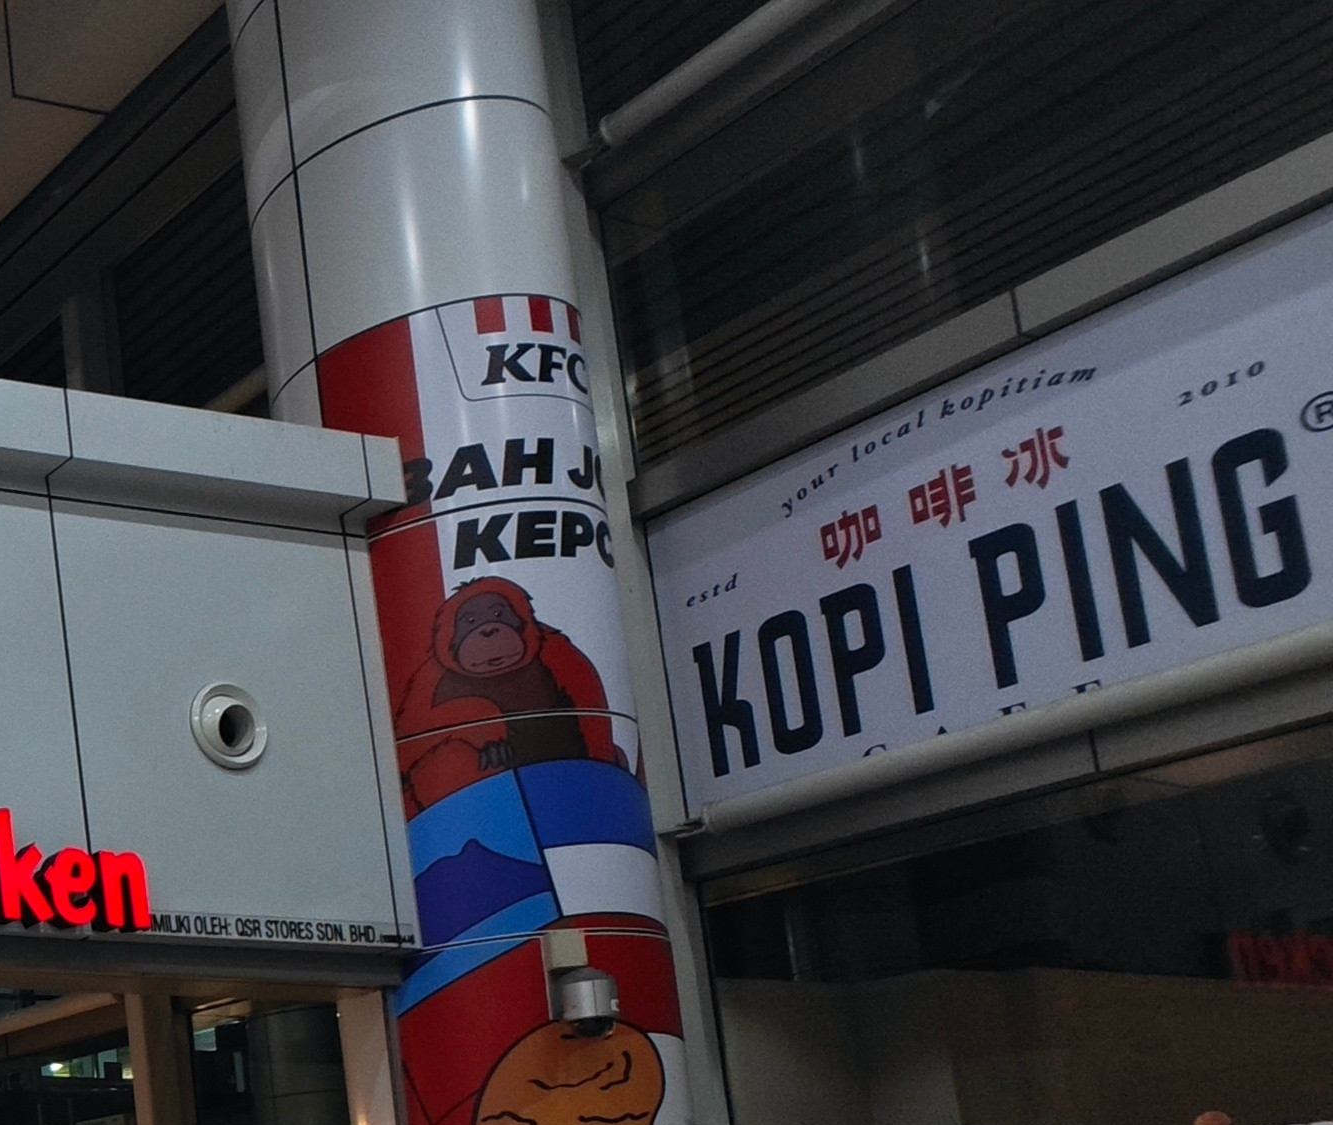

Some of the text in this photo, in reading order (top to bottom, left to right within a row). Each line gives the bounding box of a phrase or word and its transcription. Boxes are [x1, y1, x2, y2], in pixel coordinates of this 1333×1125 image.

[1177, 360, 1265, 407] 2010
[780, 364, 1098, 518] your local kopitiam
[567, 444, 606, 502] J
[819, 425, 1070, 570] 咖啡冰
[686, 573, 739, 608] estd
[692, 427, 1313, 779] KOPI PING
[194, 915, 232, 936] OLEH:
[235, 918, 262, 937] QSR
[265, 919, 314, 940] STORES
[316, 922, 346, 942] SDN.
[349, 924, 380, 943] BHD.
